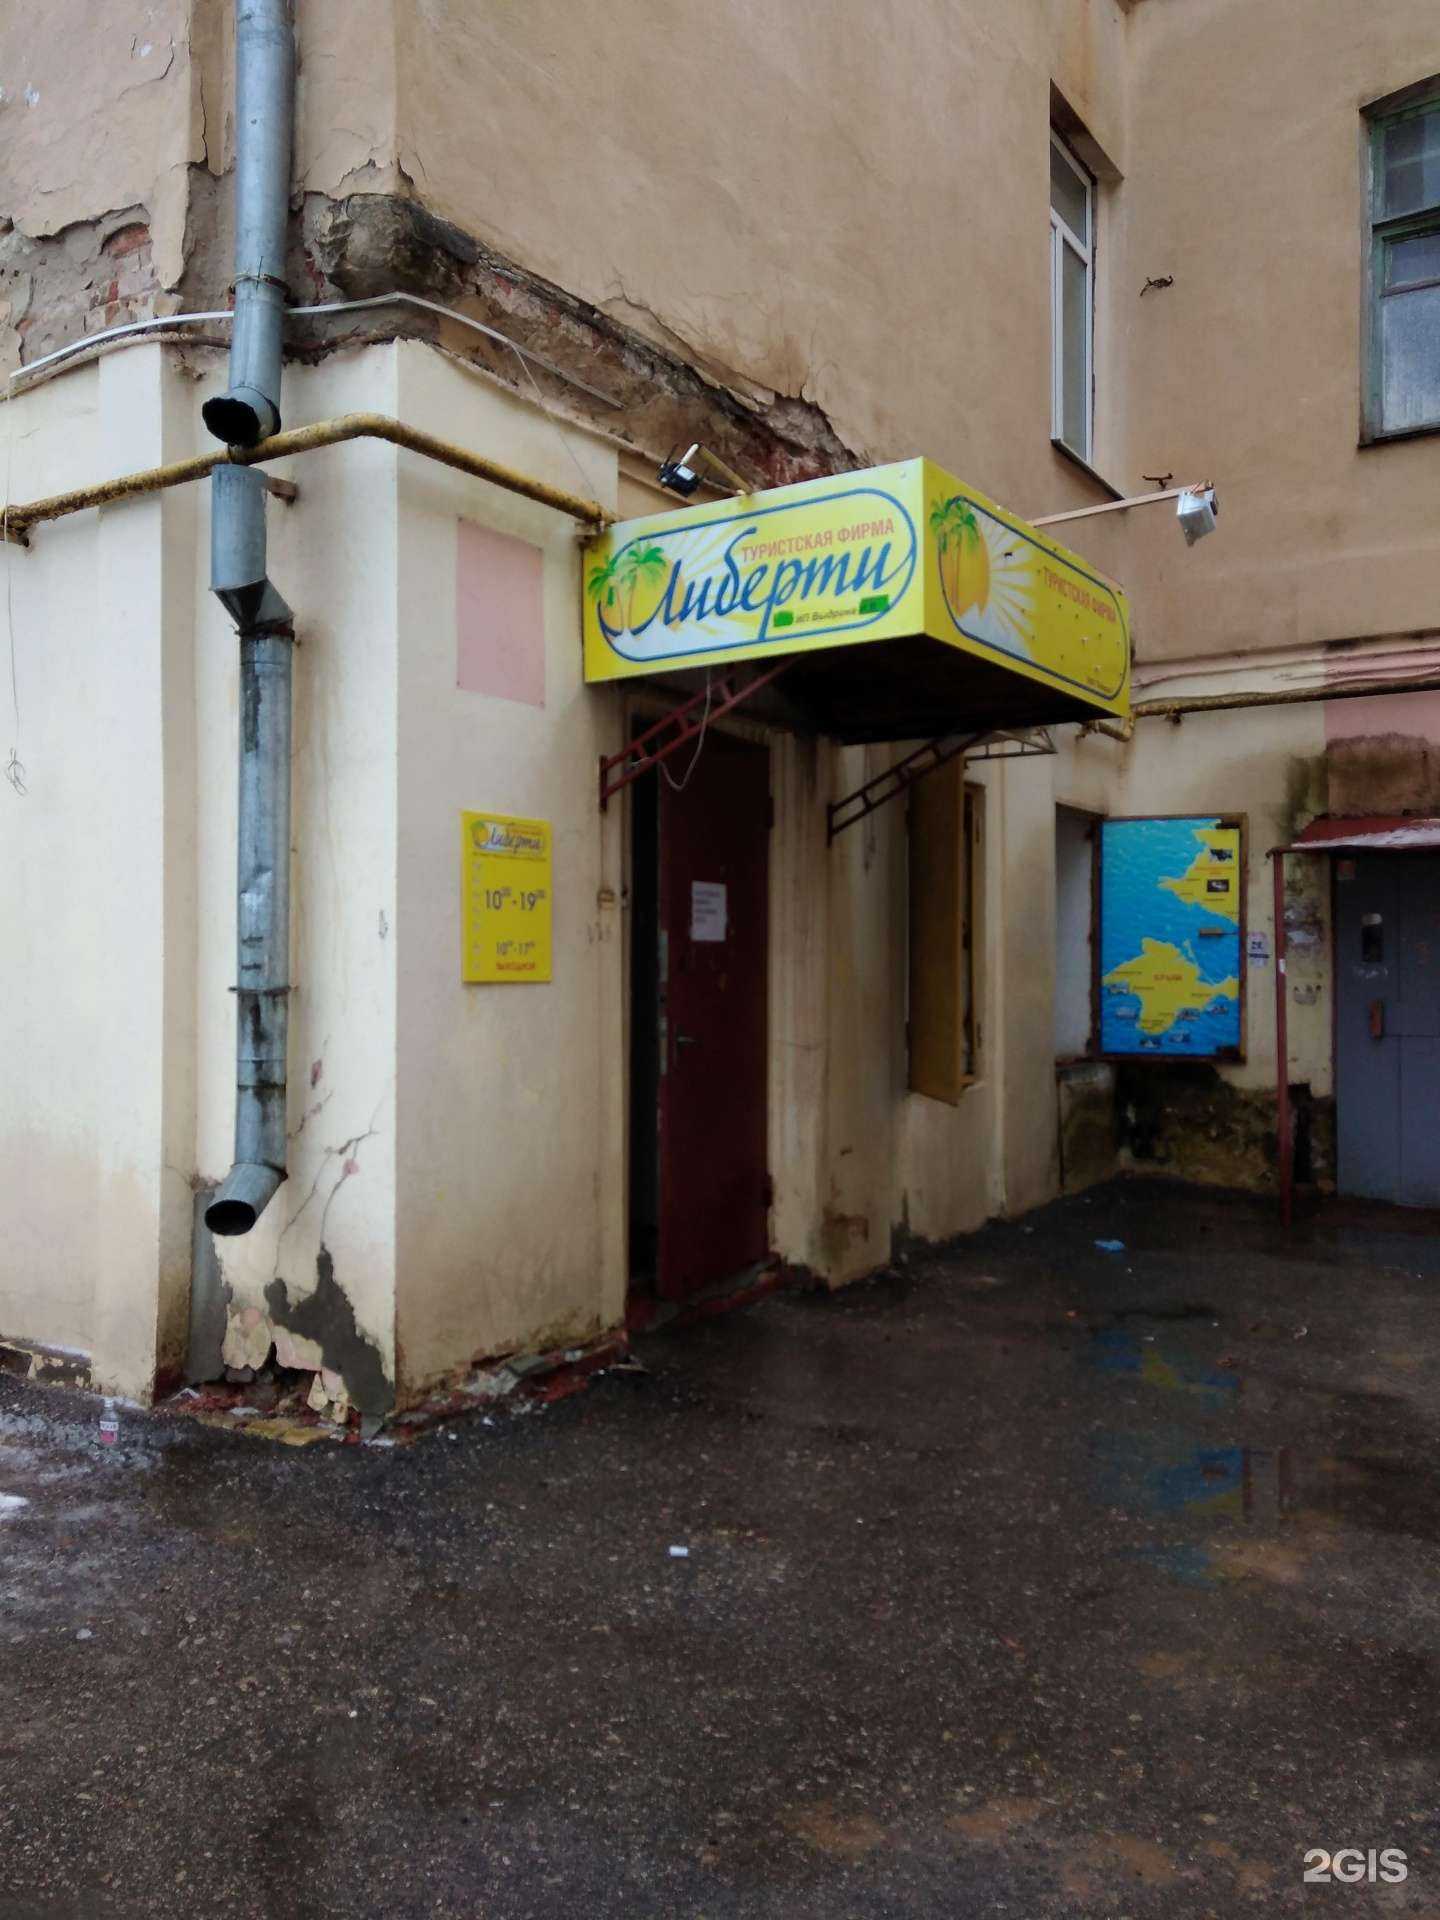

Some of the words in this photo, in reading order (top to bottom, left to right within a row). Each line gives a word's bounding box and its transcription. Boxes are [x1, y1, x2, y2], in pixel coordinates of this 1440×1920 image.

[741, 529, 833, 562] ТУРИСТСКАЯ
[836, 517, 894, 543] ФИРМА
[631, 526, 893, 642] Либерти
